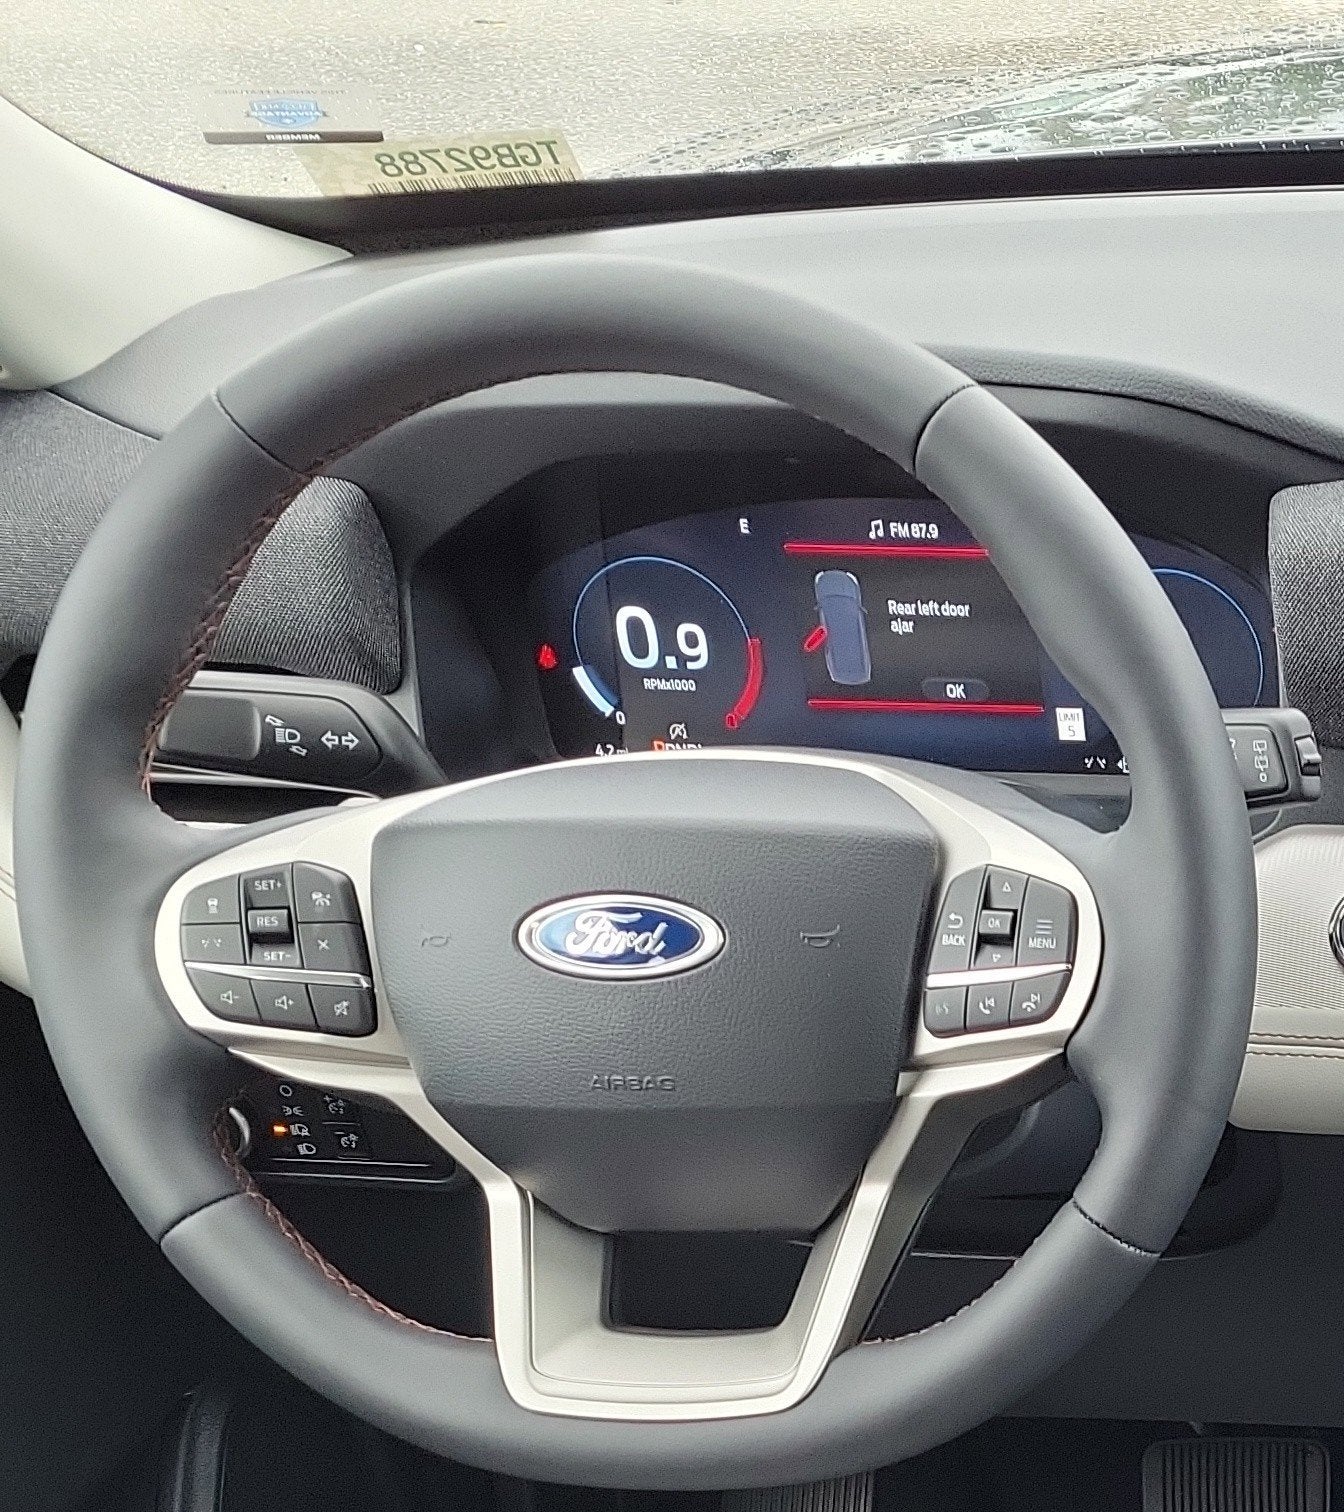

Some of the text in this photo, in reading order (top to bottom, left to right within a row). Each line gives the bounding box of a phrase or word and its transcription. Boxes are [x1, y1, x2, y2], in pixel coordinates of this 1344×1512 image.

[739, 518, 751, 535] E
[890, 522, 939, 540] FM 87.9
[887, 599, 970, 617] Rear left door
[890, 618, 914, 635] ajar
[615, 605, 709, 670] 0.9
[643, 678, 697, 692] RPMx1000
[946, 683, 966, 700] OK
[1068, 725, 1076, 737] 5
[256, 916, 279, 927] RES
[565, 909, 668, 957] Ford
[942, 934, 966, 947] BACK
[1028, 937, 1057, 949] MENU
[590, 1074, 676, 1092] AIRBAG
